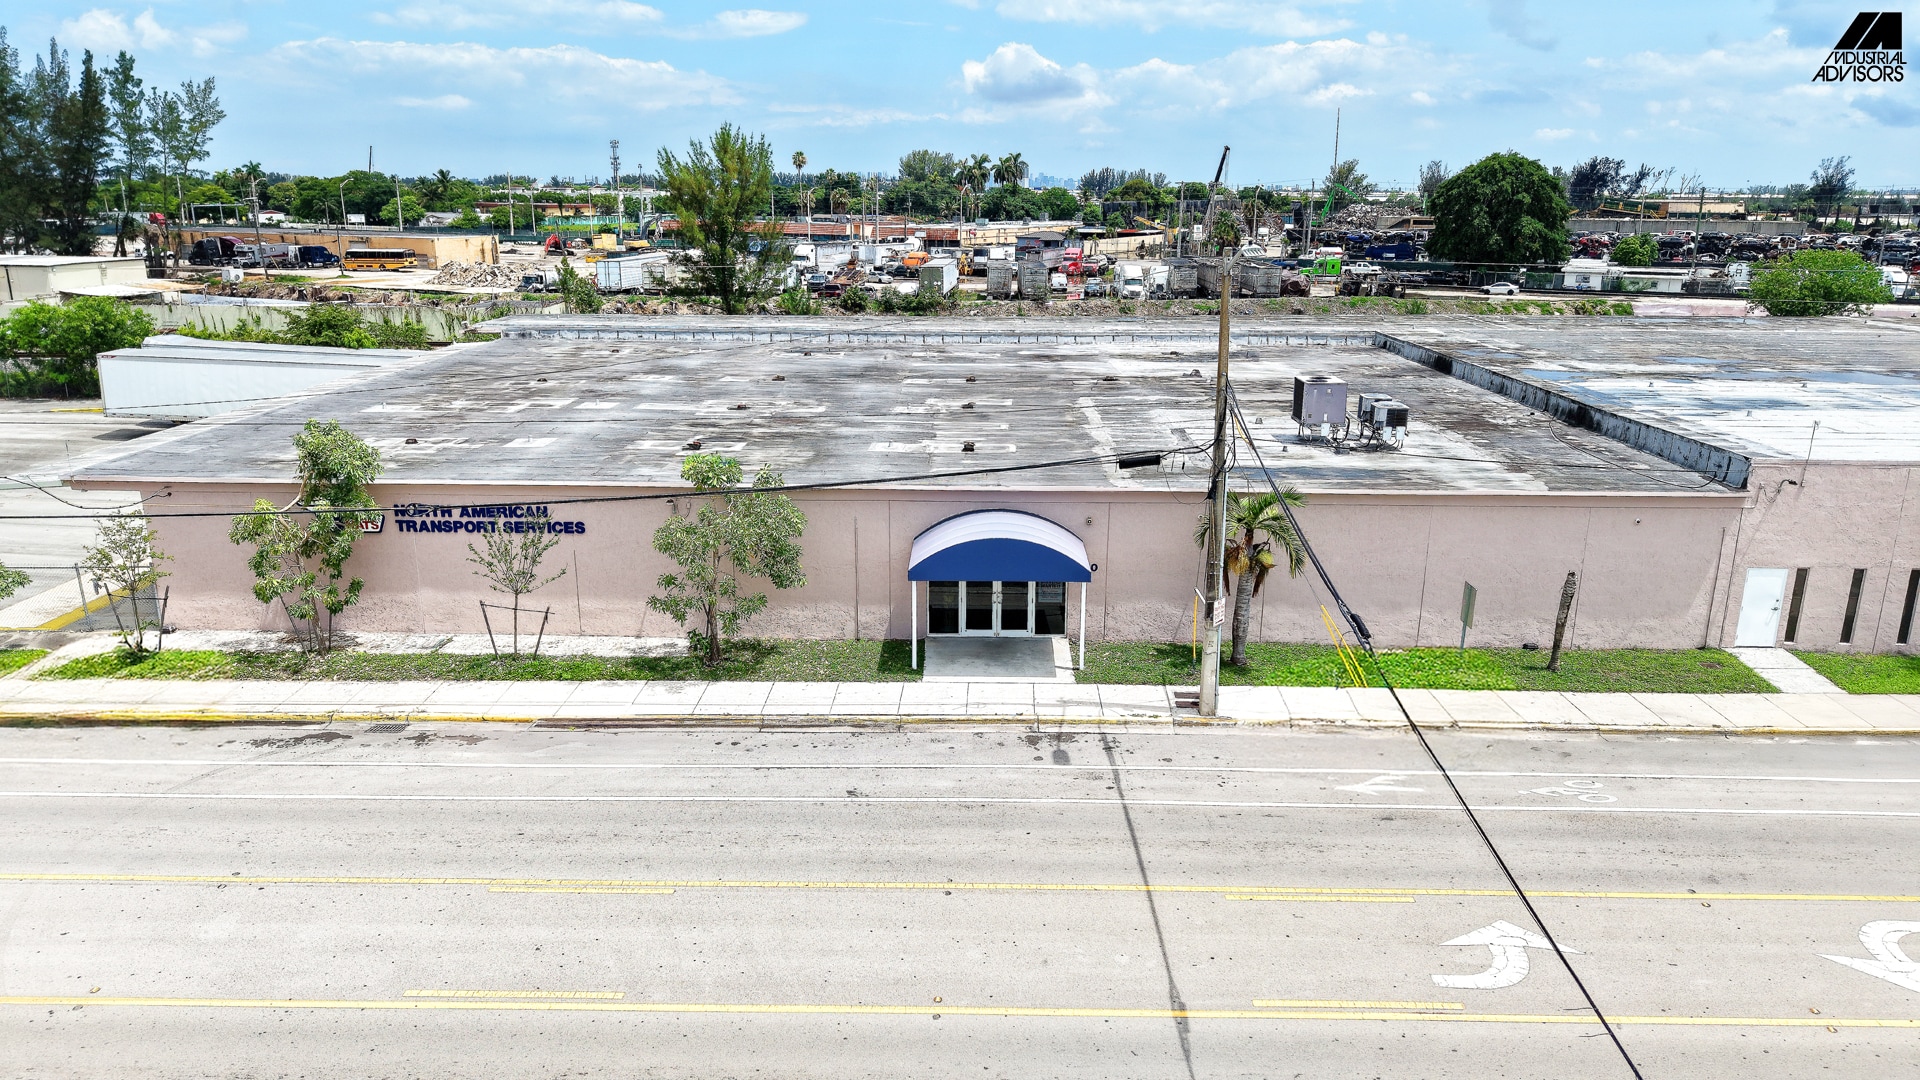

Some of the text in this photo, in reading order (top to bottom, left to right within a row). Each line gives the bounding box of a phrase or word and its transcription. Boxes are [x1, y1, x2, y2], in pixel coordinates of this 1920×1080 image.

[459, 506, 549, 518] AMERICAN
[395, 519, 586, 534] TRANSPORT SERVICES
